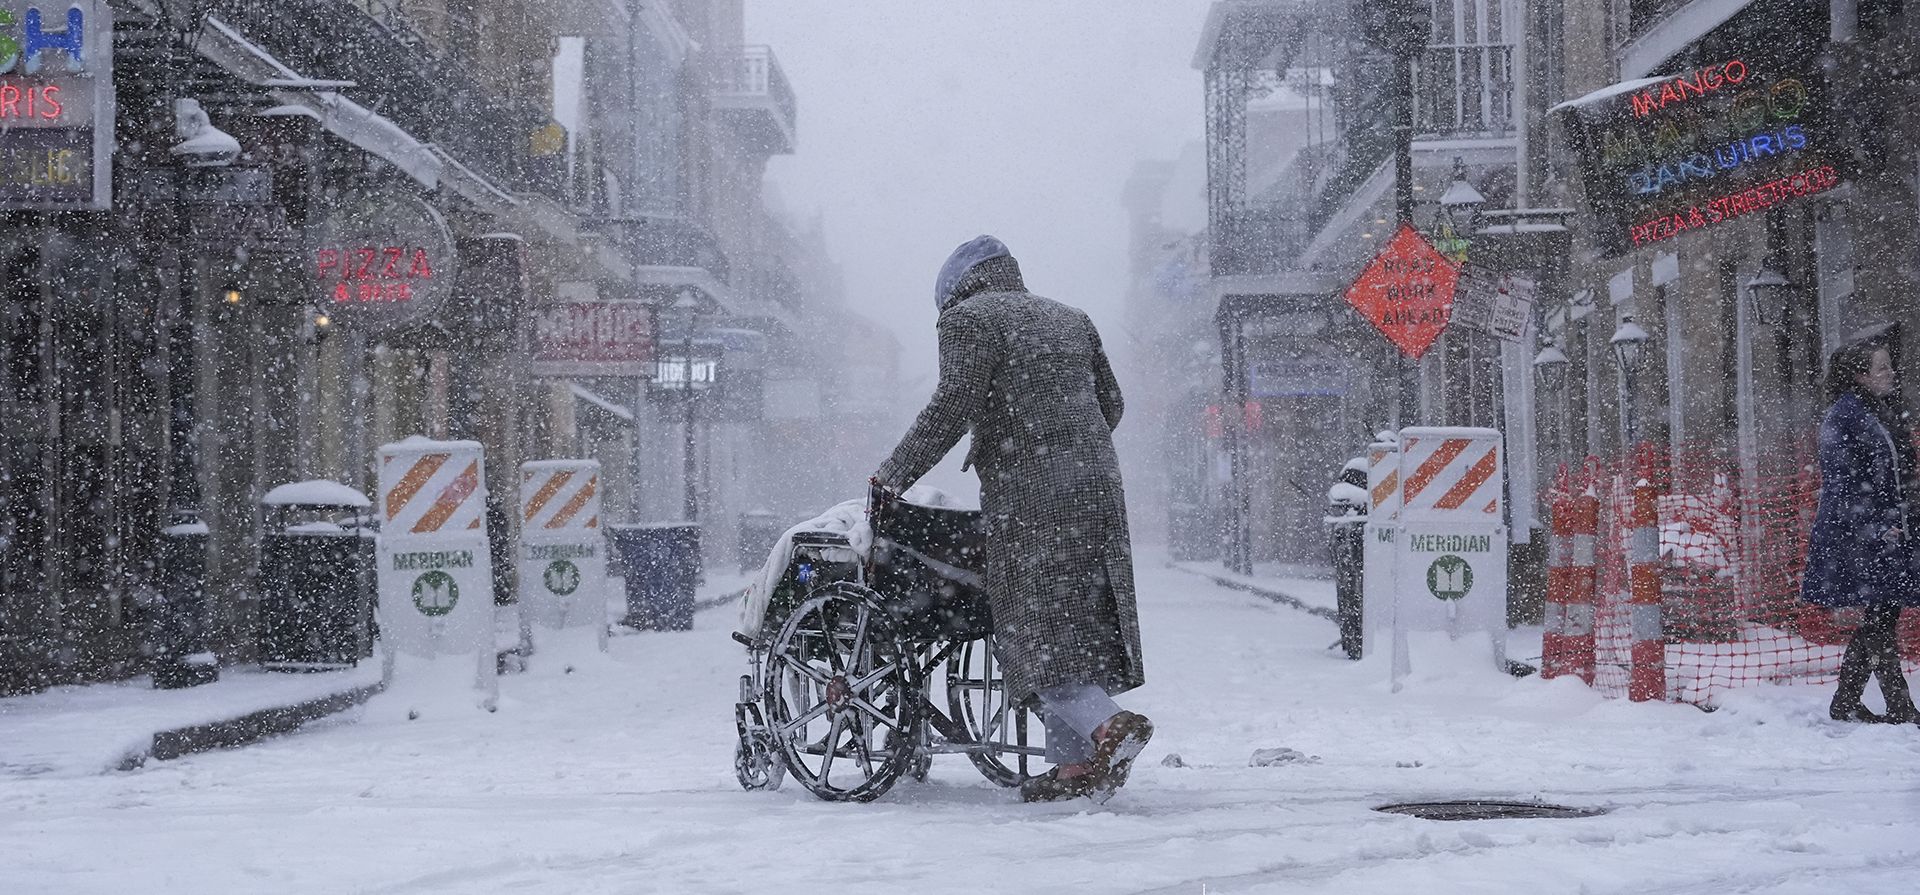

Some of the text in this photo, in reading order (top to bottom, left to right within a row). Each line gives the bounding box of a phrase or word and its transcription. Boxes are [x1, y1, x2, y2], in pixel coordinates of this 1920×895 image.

[1632, 60, 1747, 118] MANGO
[1602, 78, 1806, 166] MAGO
[1628, 125, 1807, 196] DAIQUIRIS
[1631, 213, 1689, 248] PIZZA
[1688, 206, 1707, 229] &
[317, 247, 432, 281] PIZZA
[1384, 257, 1435, 273] ROAD
[334, 282, 351, 302] &
[1388, 284, 1435, 301] WORK
[1383, 308, 1444, 325] AHEAD
[531, 543, 595, 561] MERIDIAN
[1410, 534, 1491, 553] MERIDIAN
[393, 549, 474, 571] MERIDIAN
